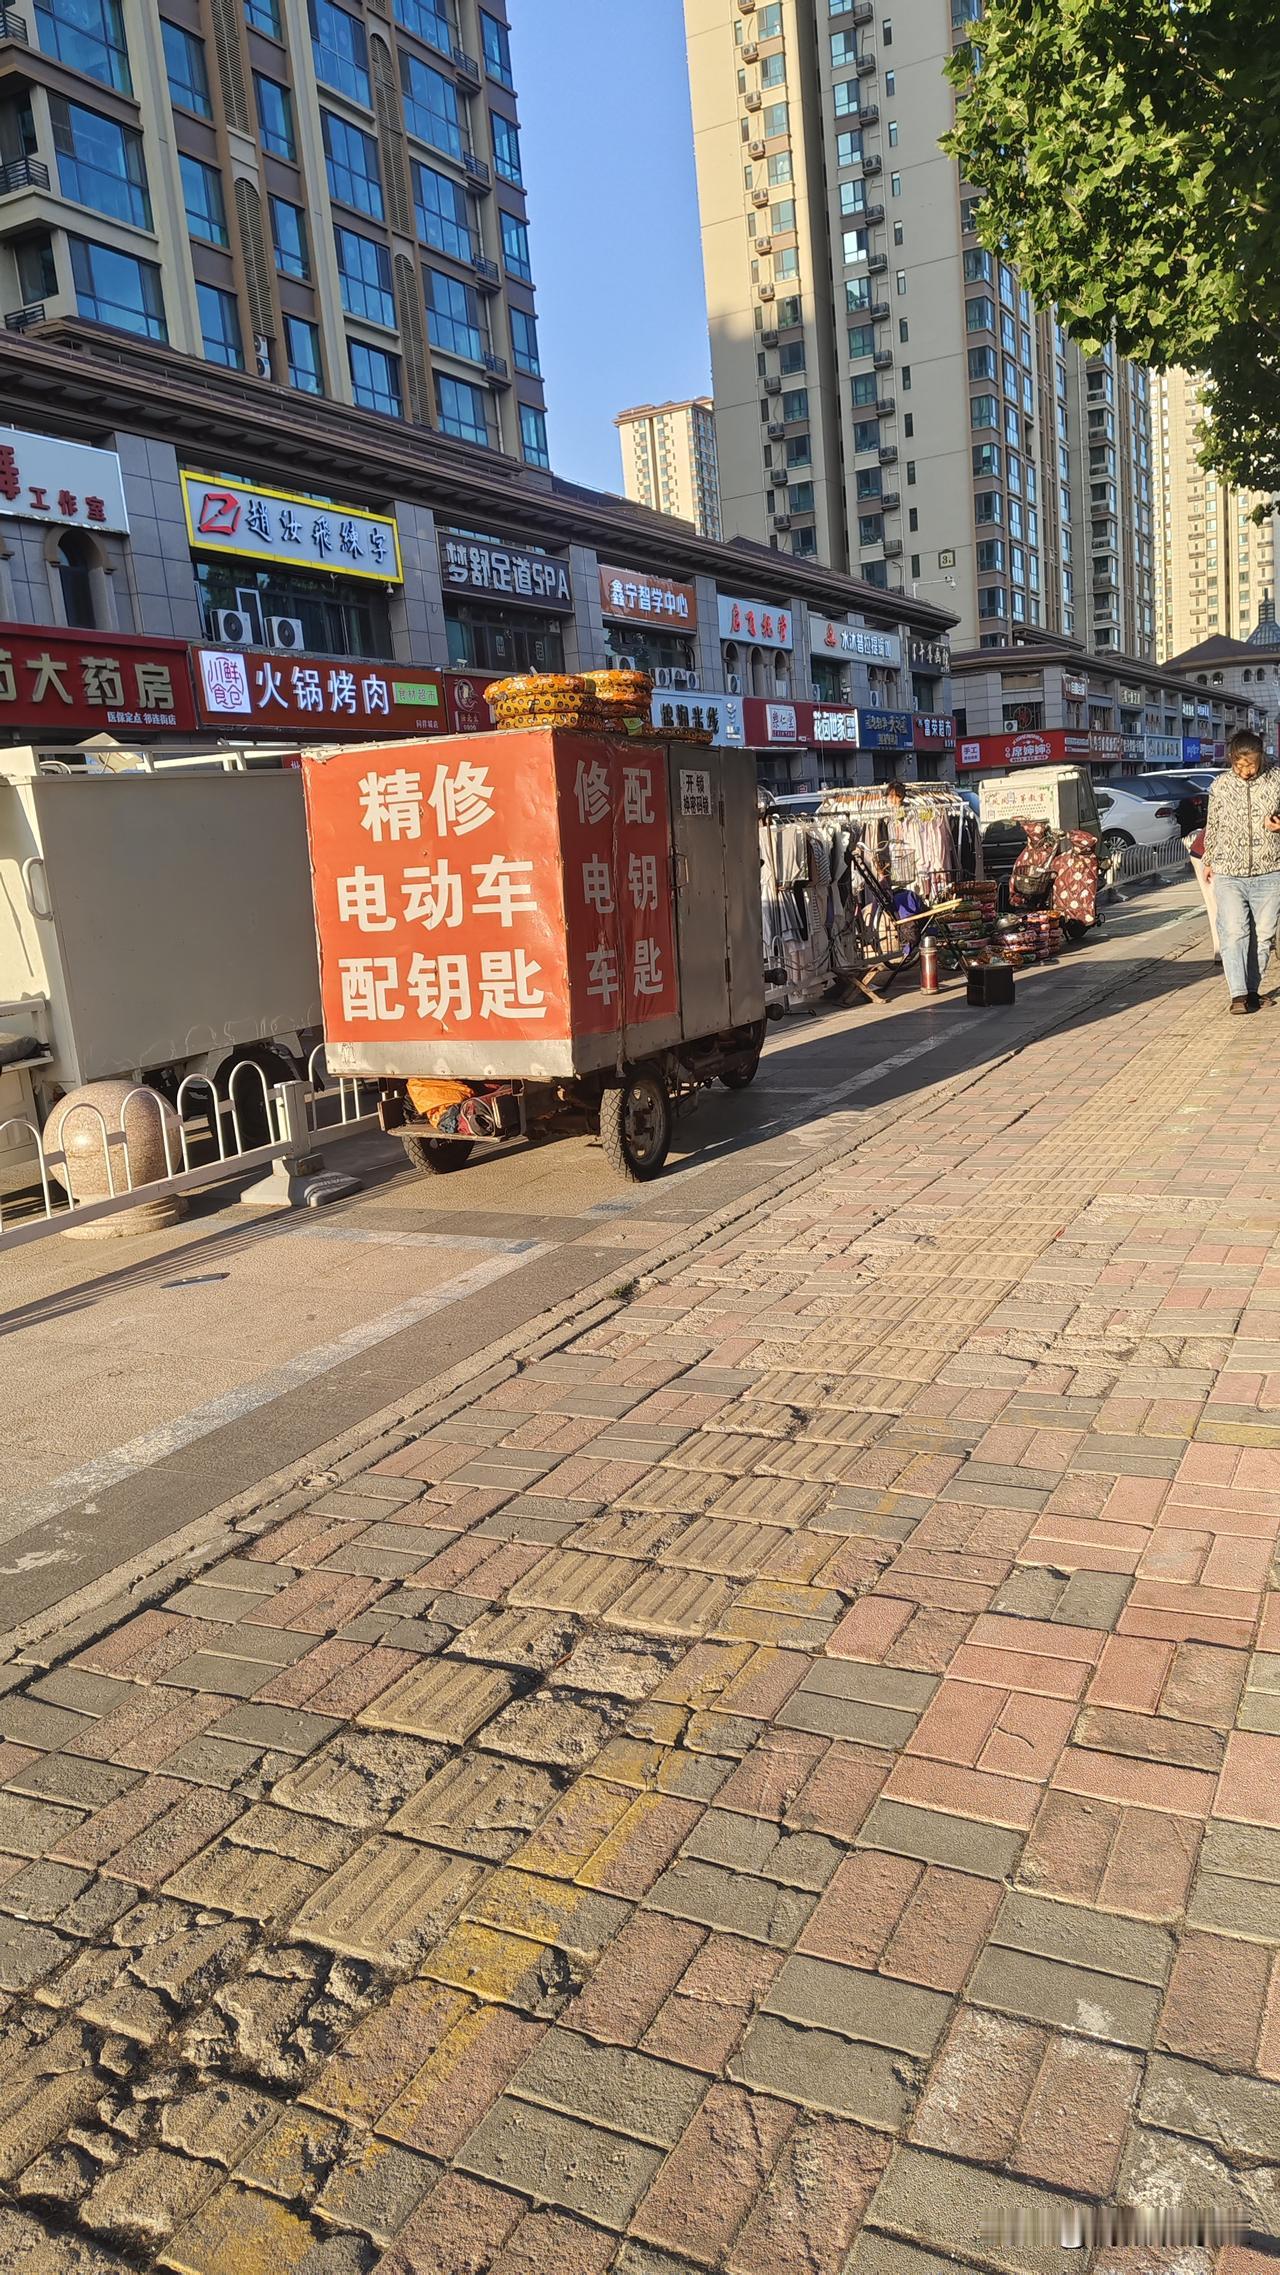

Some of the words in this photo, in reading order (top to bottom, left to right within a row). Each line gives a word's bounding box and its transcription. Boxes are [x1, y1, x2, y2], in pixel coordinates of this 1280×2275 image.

[29, 487, 106, 522] 工作室
[609, 579, 689, 618] 鑫宁智学中心
[256, 662, 390, 715] 火锅烤肉
[399, 687, 435, 702] 食材超市
[107, 711, 142, 724] 医保定点
[143, 713, 177, 725] 祁连街店
[358, 760, 496, 842] 精修
[685, 774, 705, 794] 开锁
[336, 854, 538, 932] 电动车
[338, 948, 548, 1023] 配钥匙
